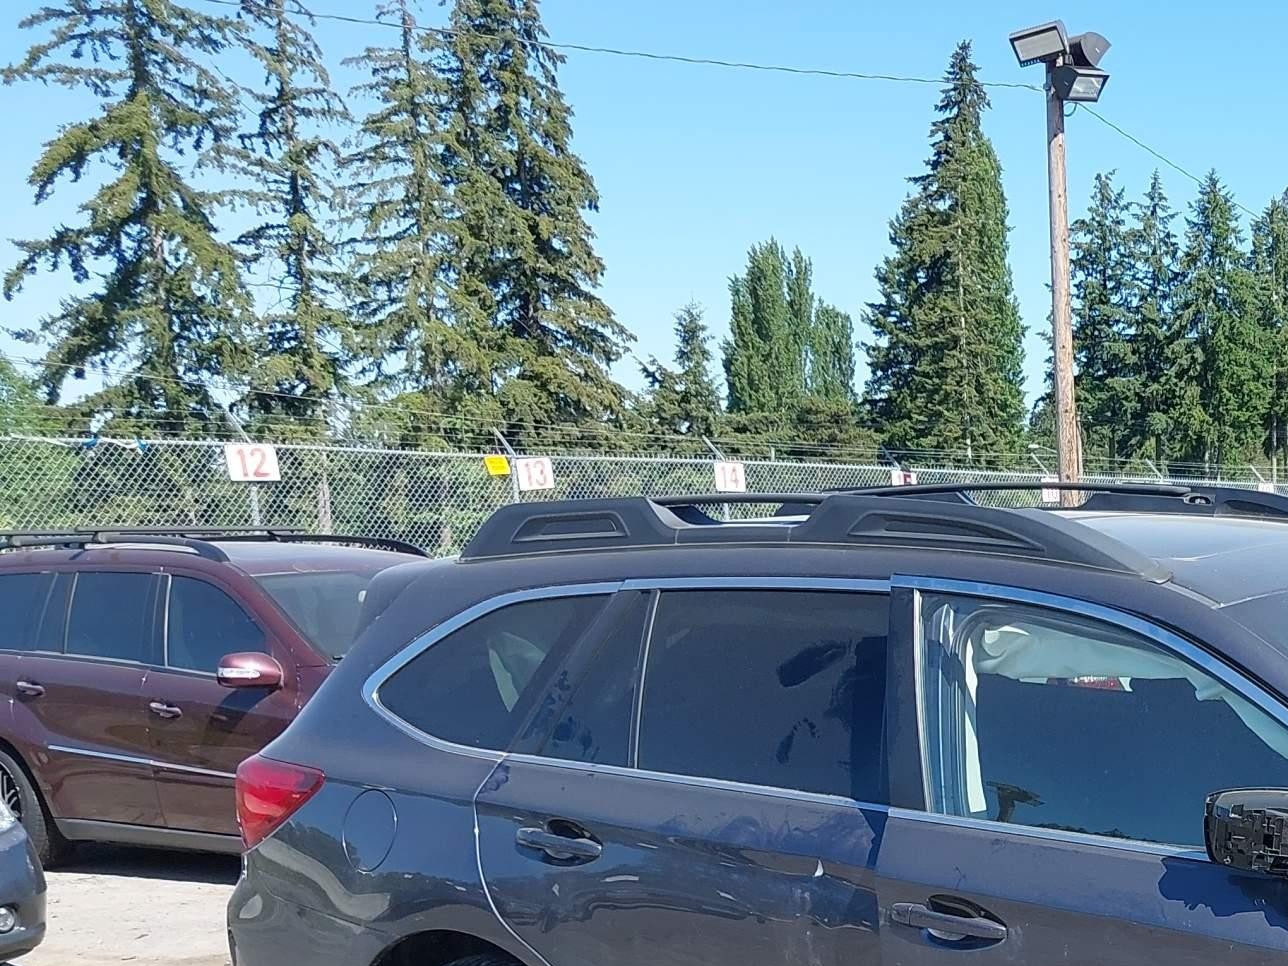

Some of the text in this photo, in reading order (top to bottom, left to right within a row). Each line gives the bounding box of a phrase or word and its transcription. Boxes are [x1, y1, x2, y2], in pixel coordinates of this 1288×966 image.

[236, 448, 270, 477] 12
[524, 460, 547, 486] 13
[721, 465, 739, 489] 14
